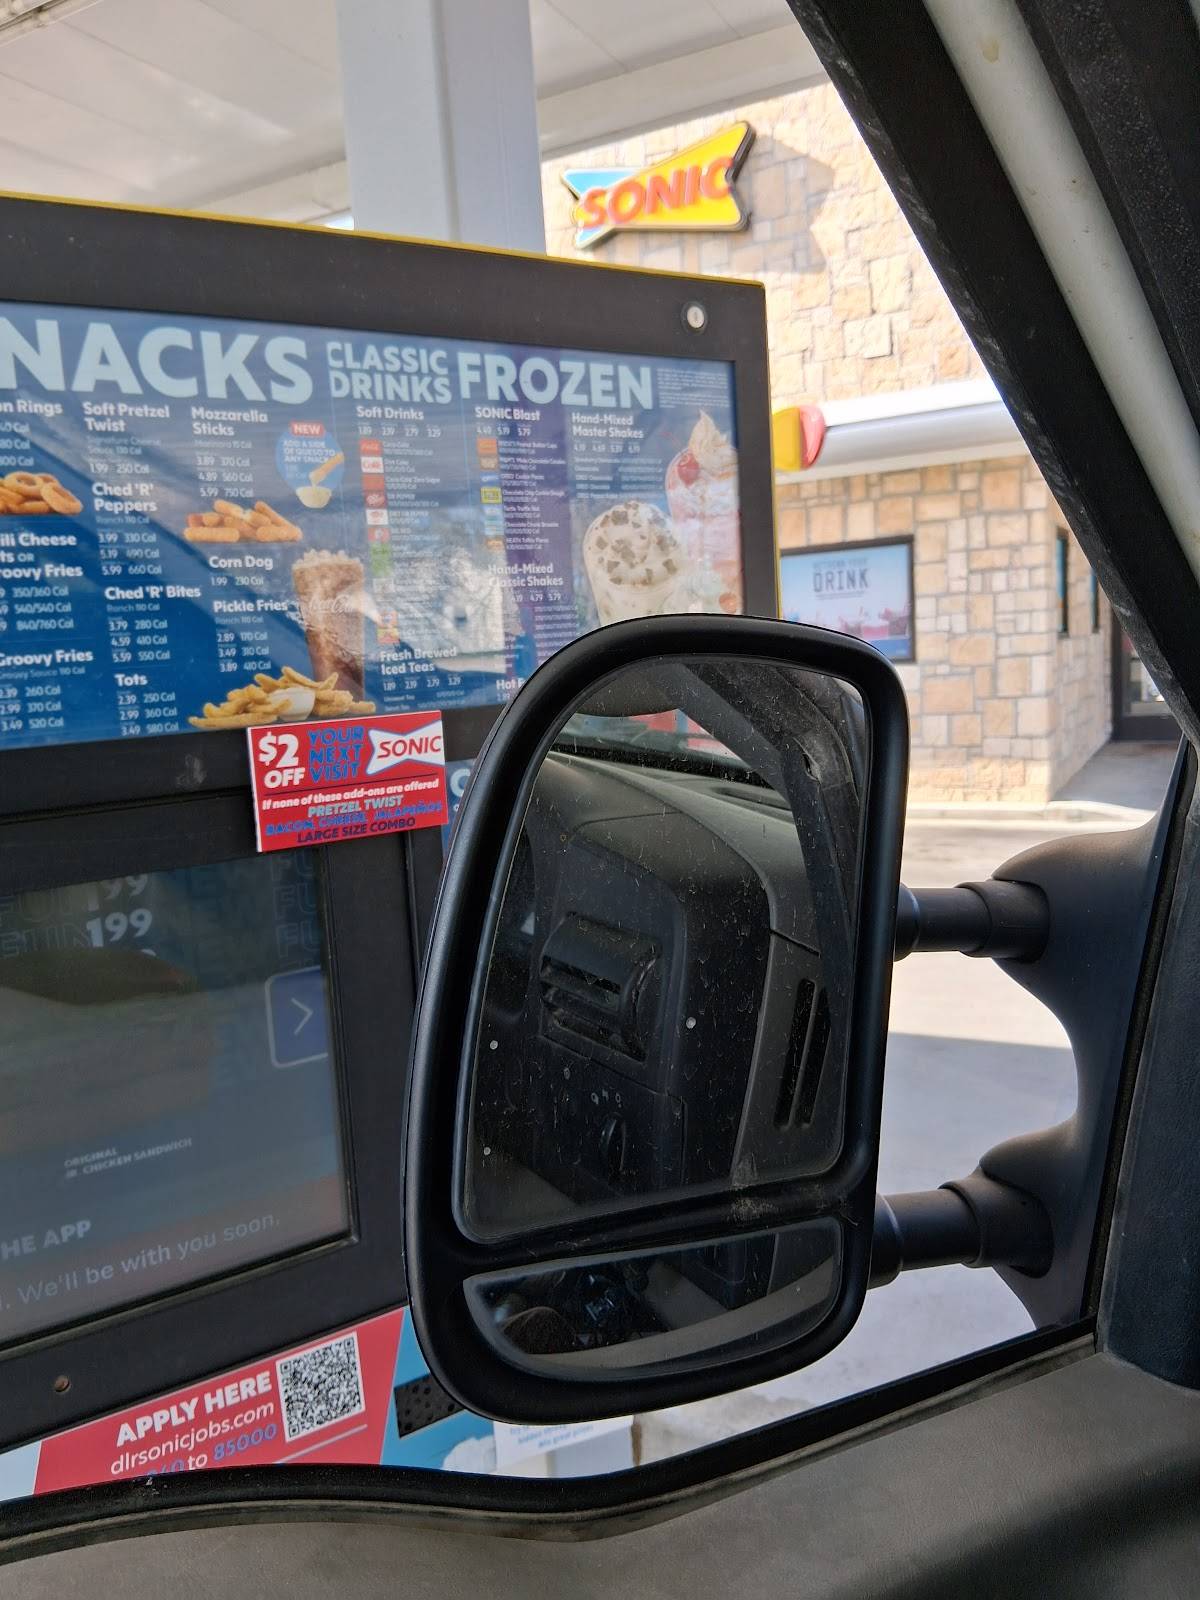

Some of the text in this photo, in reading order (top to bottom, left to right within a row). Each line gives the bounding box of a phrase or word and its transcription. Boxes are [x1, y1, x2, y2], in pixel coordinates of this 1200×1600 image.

[578, 156, 734, 230] SONIC
[326, 342, 449, 375] CLASSIC
[329, 370, 452, 404] DRINKS
[457, 352, 653, 410] FROZEN
[16, 399, 63, 417] Rings
[82, 401, 170, 418] Soft Pretzel
[191, 406, 269, 423] Mozzarella
[356, 405, 424, 420] Soft Drinks
[475, 407, 541, 421] SONIC Blast
[84, 417, 126, 432] Twist
[572, 412, 633, 425] Hand-Mixed
[192, 422, 235, 436] Sticks
[293, 423, 321, 435] NEW
[572, 425, 644, 439] Master Shakes
[92, 482, 154, 496] Ched 'R'
[94, 498, 158, 514] Peppers
[18, 532, 77, 546] Cheese
[44, 563, 84, 577] Fries
[209, 556, 274, 571] Corn Dog
[488, 563, 554, 574] Hand-Mixed
[527, 575, 564, 587] Shakes
[813, 568, 869, 593] DRINK
[105, 586, 202, 600] Ched 'R' Bites
[213, 599, 288, 613] Pickle Fries
[55, 649, 94, 663] Fries
[380, 647, 457, 662] Fresh Brewed
[381, 662, 435, 675] Iced Teas
[114, 673, 148, 687] Tots
[496, 679, 516, 690] Hot
[308, 726, 364, 746] YOUR
[259, 731, 299, 768] $2
[309, 744, 363, 765] NEXT
[377, 735, 442, 758] SONIC
[264, 767, 306, 788] OFF
[309, 762, 360, 783] VISIT
[262, 779, 440, 811] If none of these add-ons are offered
[308, 794, 404, 818] PRETZEL TWIST
[297, 827, 339, 843] LARGE
[342, 823, 368, 836] SIZE
[370, 817, 416, 832] COMBO
[86, 908, 152, 947] 199
[64, 1147, 117, 1168] ORIGINAL
[82, 1154, 132, 1175] CHICKEN
[133, 1137, 193, 1161] SANDWICH
[43, 1219, 92, 1248] APP
[16, 1270, 78, 1304] We'll
[85, 1263, 114, 1284] be
[121, 1243, 171, 1273] with
[177, 1233, 217, 1261] you
[223, 1212, 280, 1243] soon.
[116, 1371, 273, 1448] APPLY HERE
[110, 1401, 275, 1476] dlrsonicjobs.com
[187, 1453, 208, 1470] to
[213, 1423, 277, 1461] 85000
